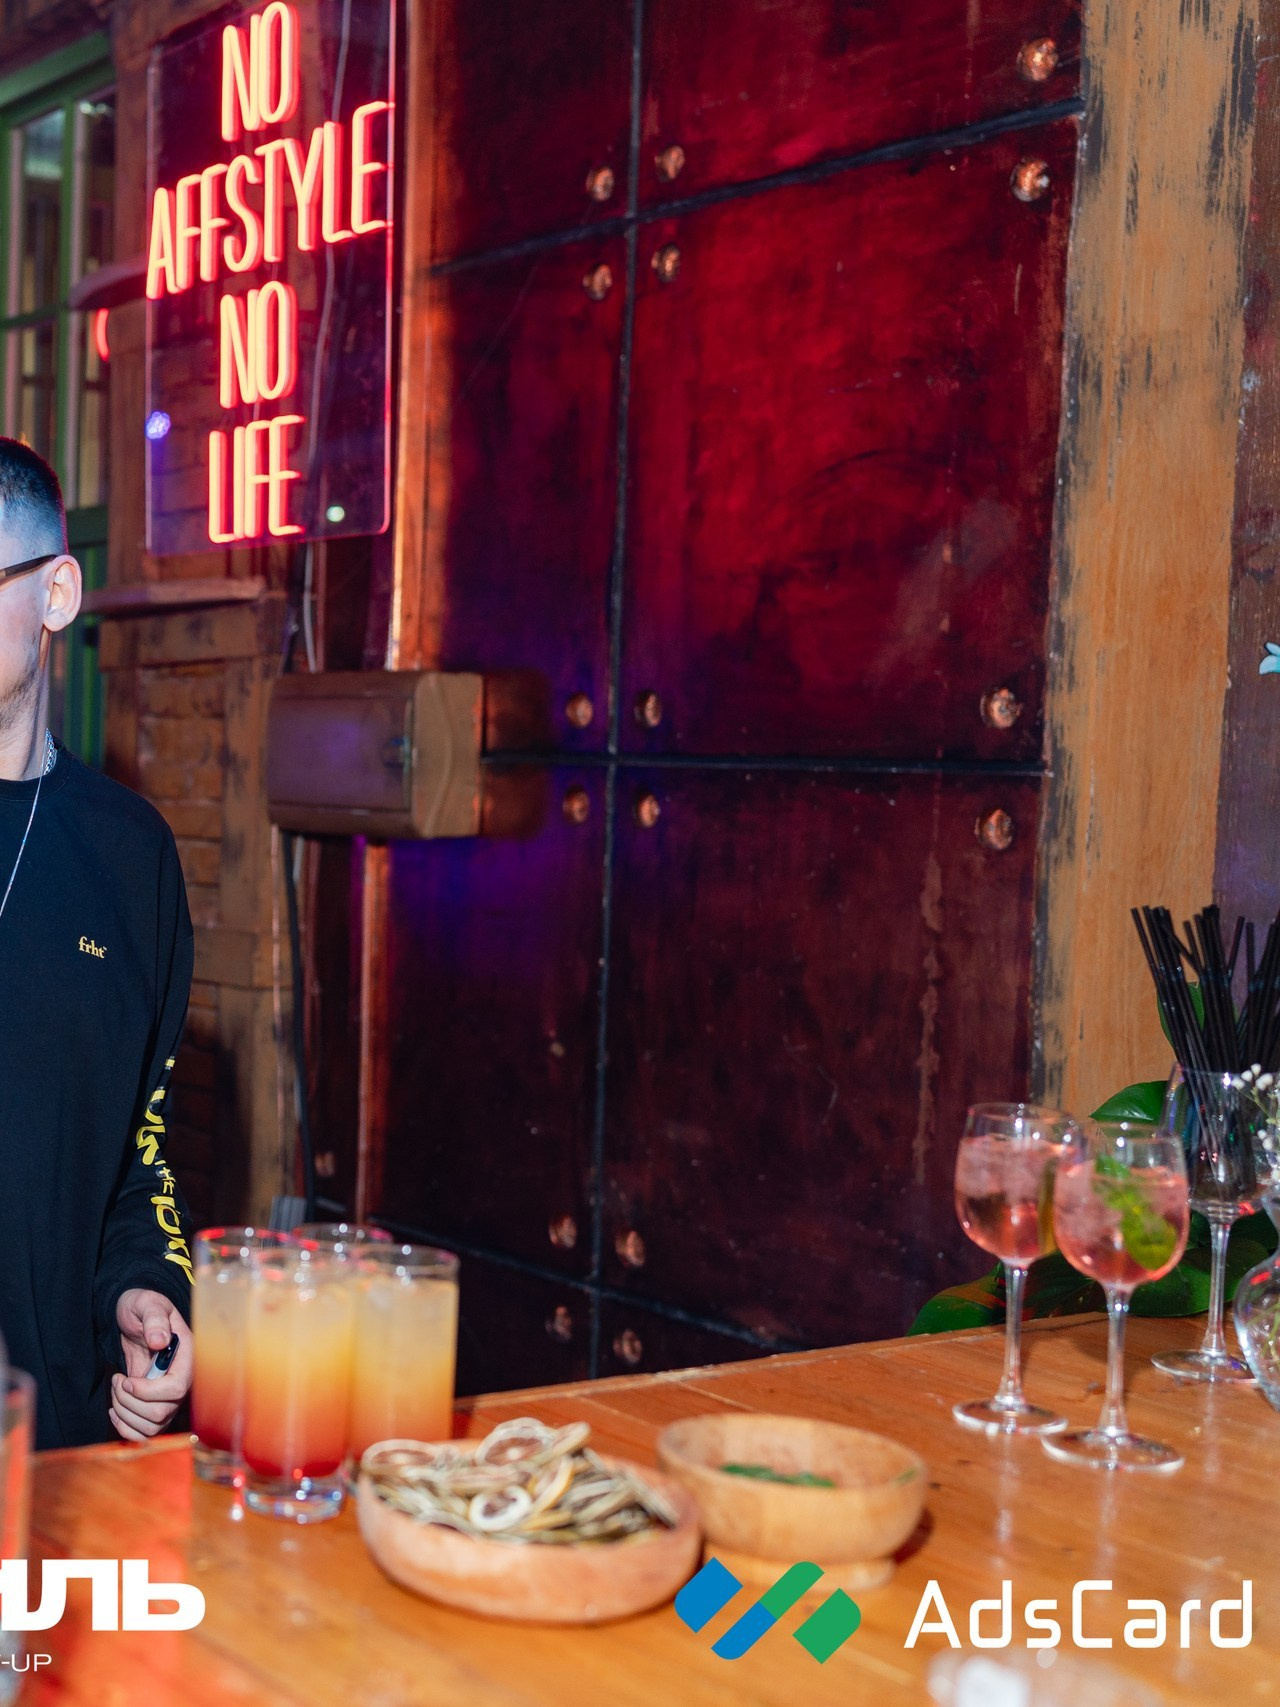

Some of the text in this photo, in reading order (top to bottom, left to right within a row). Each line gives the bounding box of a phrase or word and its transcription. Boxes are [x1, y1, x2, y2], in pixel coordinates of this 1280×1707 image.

[221, 1, 295, 142] NO
[146, 101, 394, 300] AFFSTYLE
[220, 281, 292, 408] NO
[208, 415, 305, 543] LIFE
